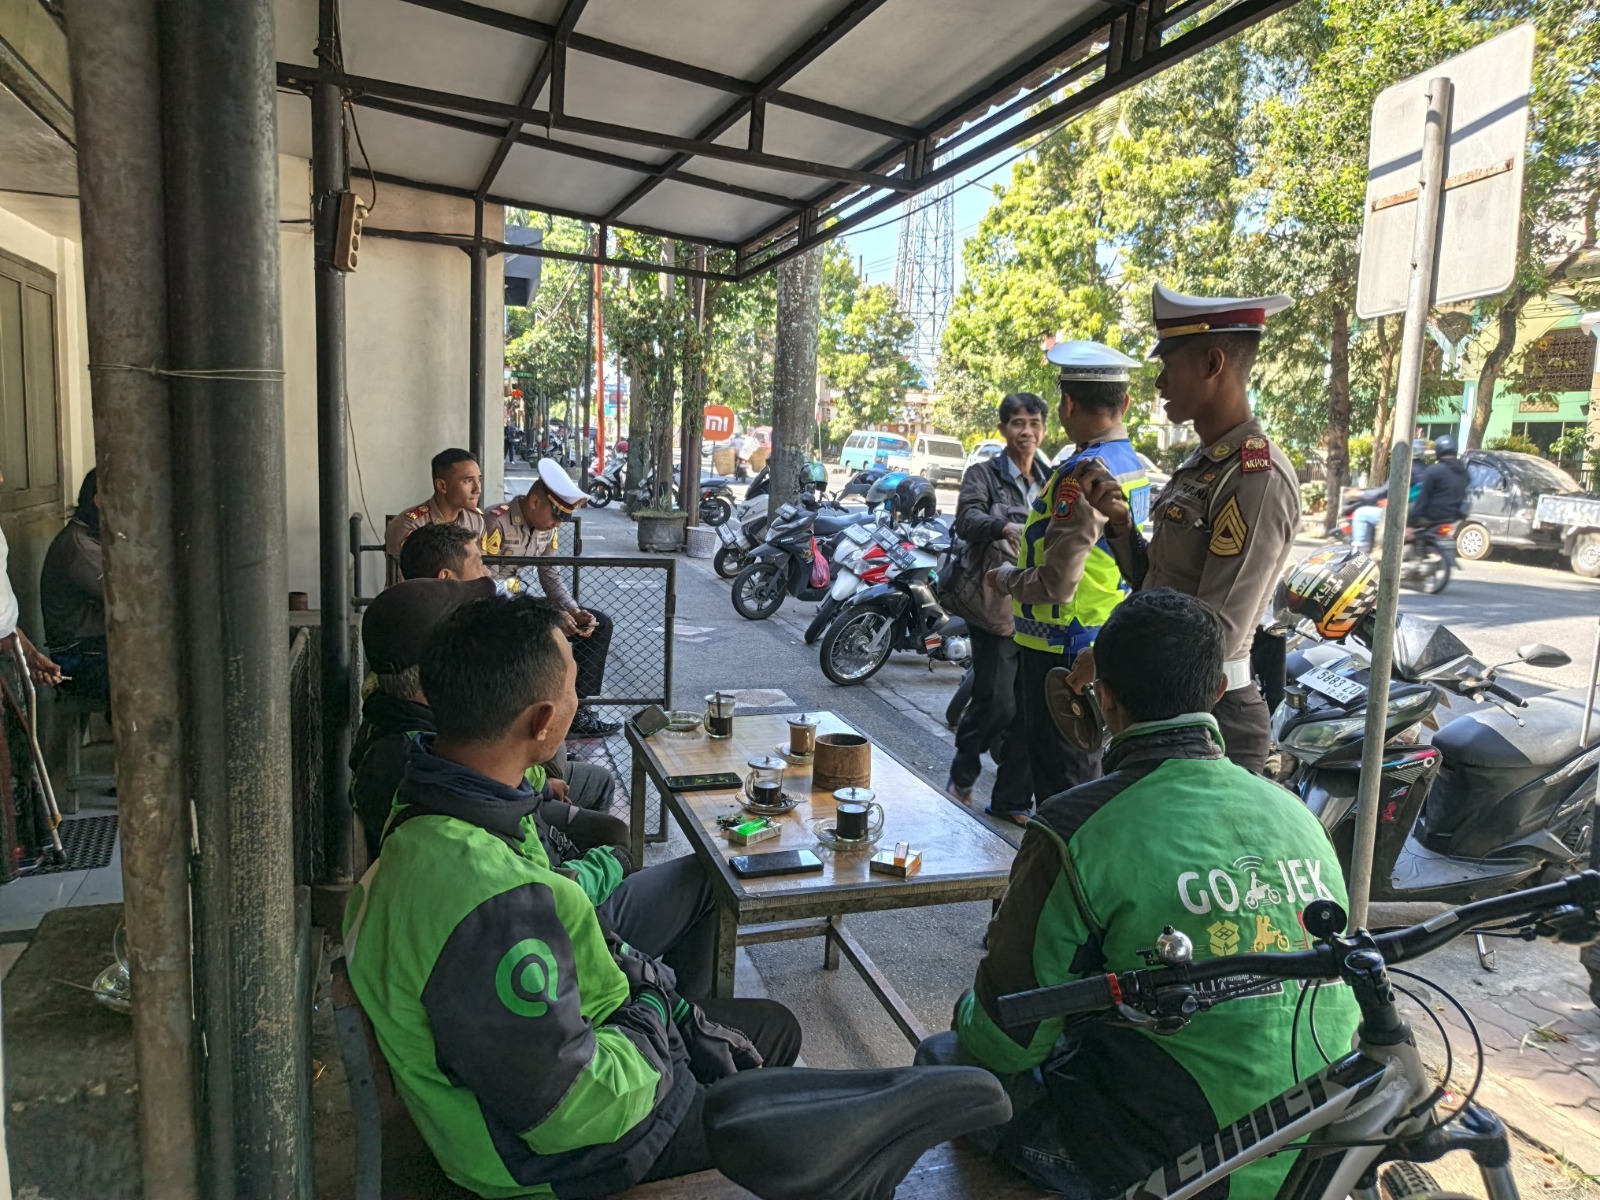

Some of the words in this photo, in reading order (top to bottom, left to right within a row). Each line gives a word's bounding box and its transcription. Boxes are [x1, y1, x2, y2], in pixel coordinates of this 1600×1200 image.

[1313, 573, 1340, 603] KYT
[1177, 868, 1240, 915] GO
[1278, 858, 1335, 904] JEK
